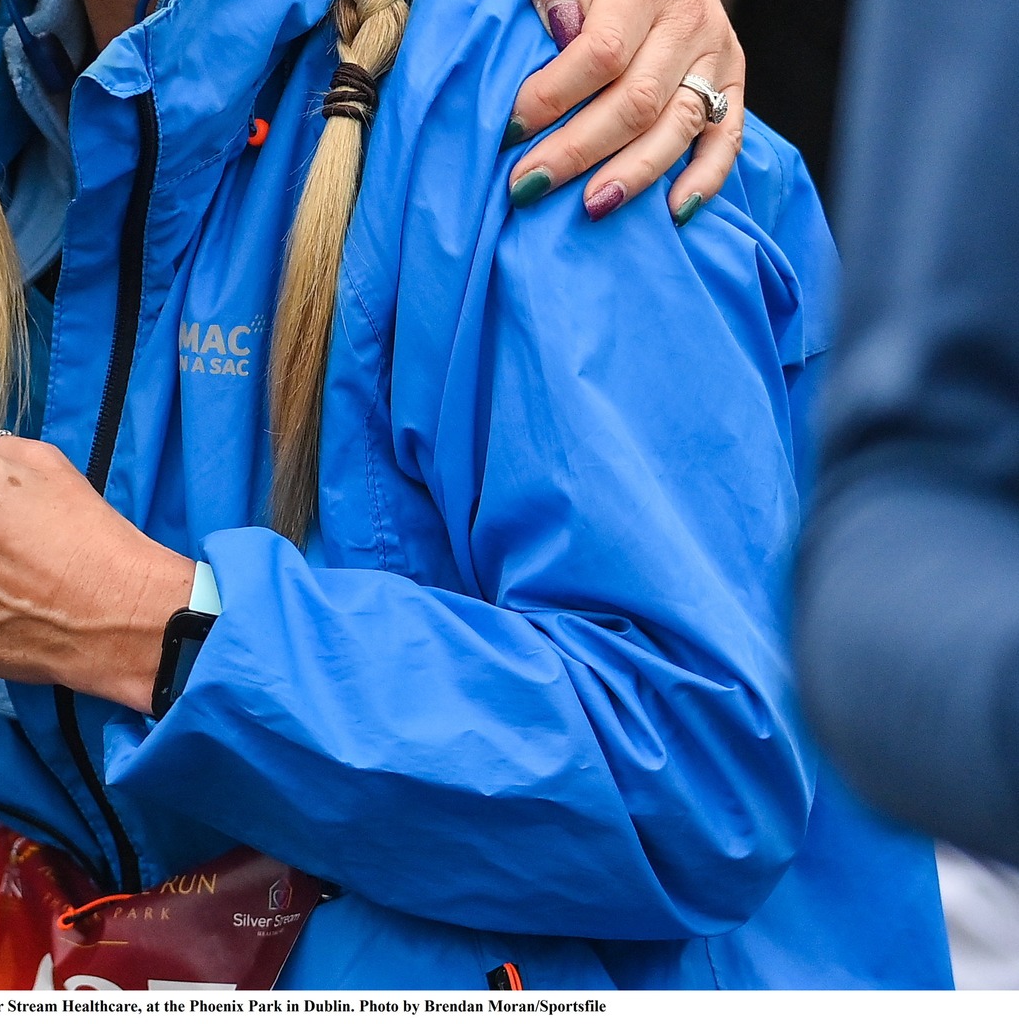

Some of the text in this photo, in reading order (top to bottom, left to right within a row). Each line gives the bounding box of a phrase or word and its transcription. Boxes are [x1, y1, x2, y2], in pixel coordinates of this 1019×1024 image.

[179, 320, 251, 356] MAC
[191, 356, 206, 374] A
[209, 357, 250, 377] SAC
[112, 906, 171, 921] PARK
[232, 912, 273, 928] Silver
